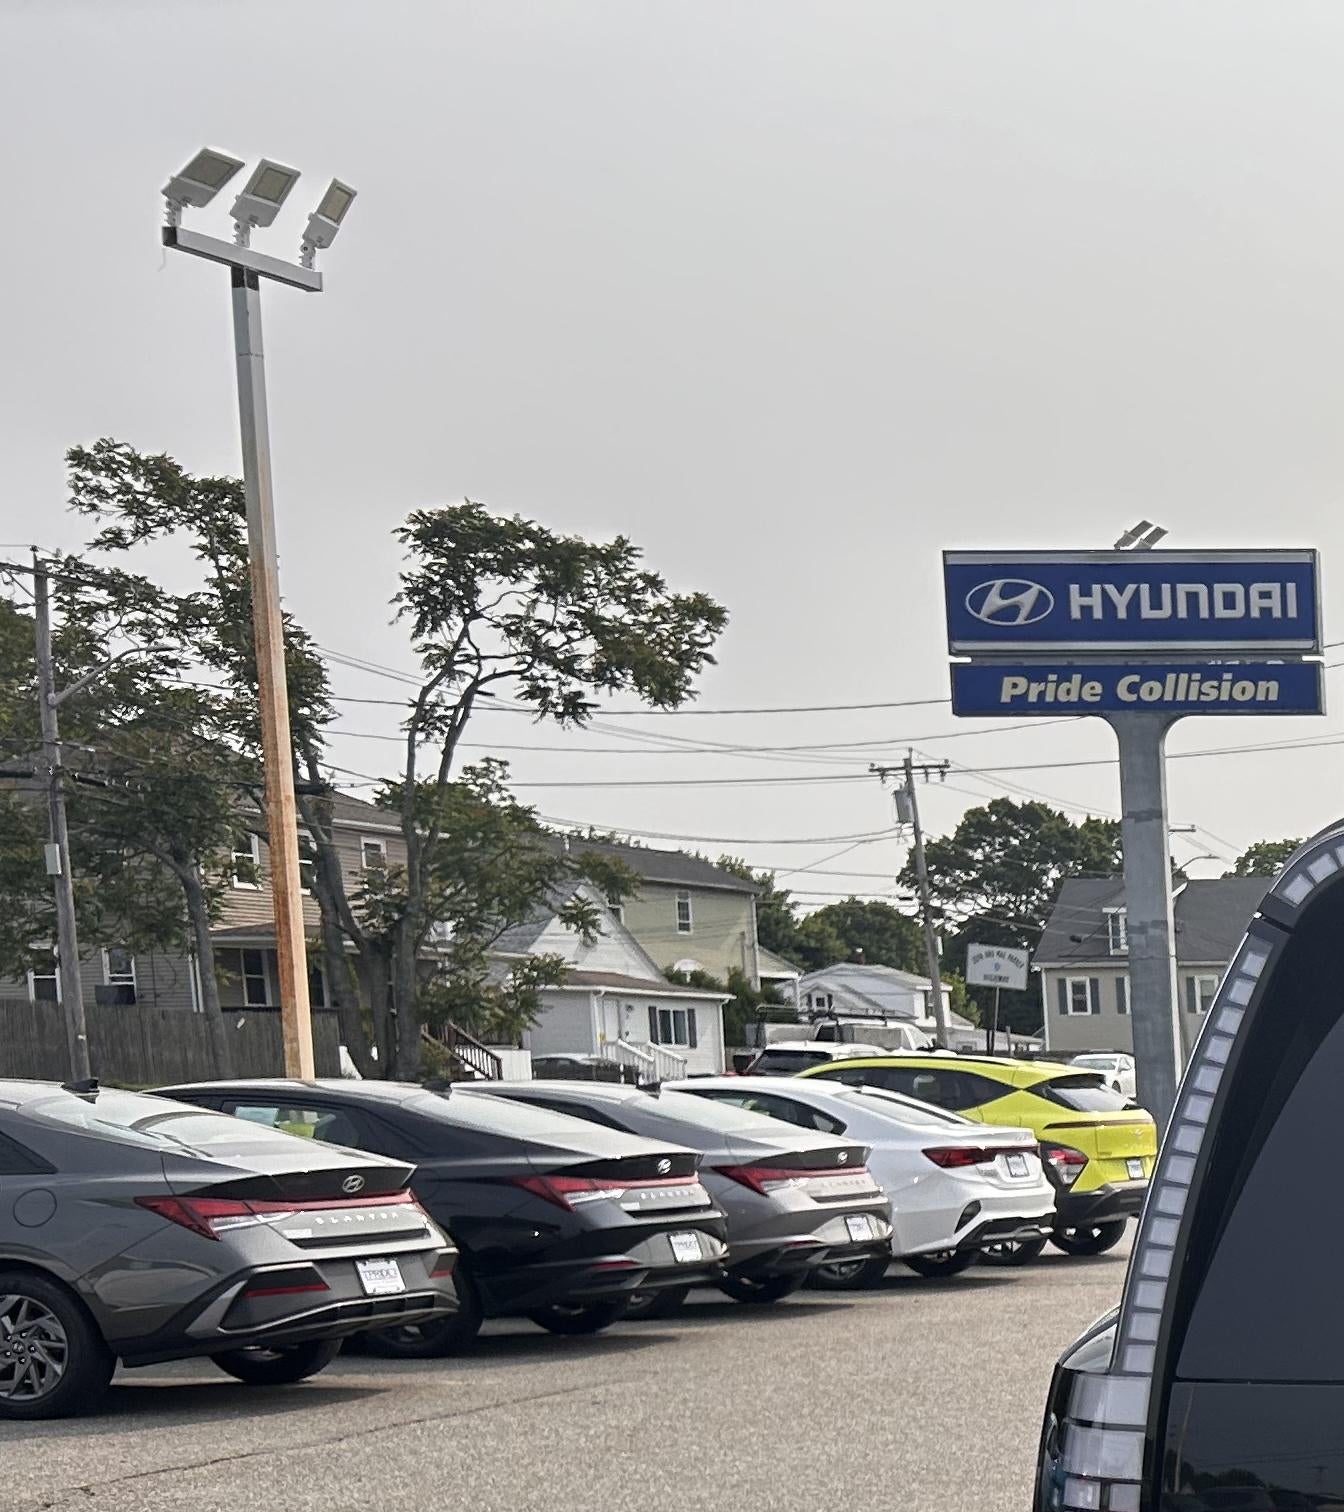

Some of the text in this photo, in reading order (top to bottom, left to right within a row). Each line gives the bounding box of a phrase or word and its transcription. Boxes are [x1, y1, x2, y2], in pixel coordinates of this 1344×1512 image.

[1069, 582, 1298, 620] HYUNDAI
[1000, 673, 1280, 703] Pride Collision
